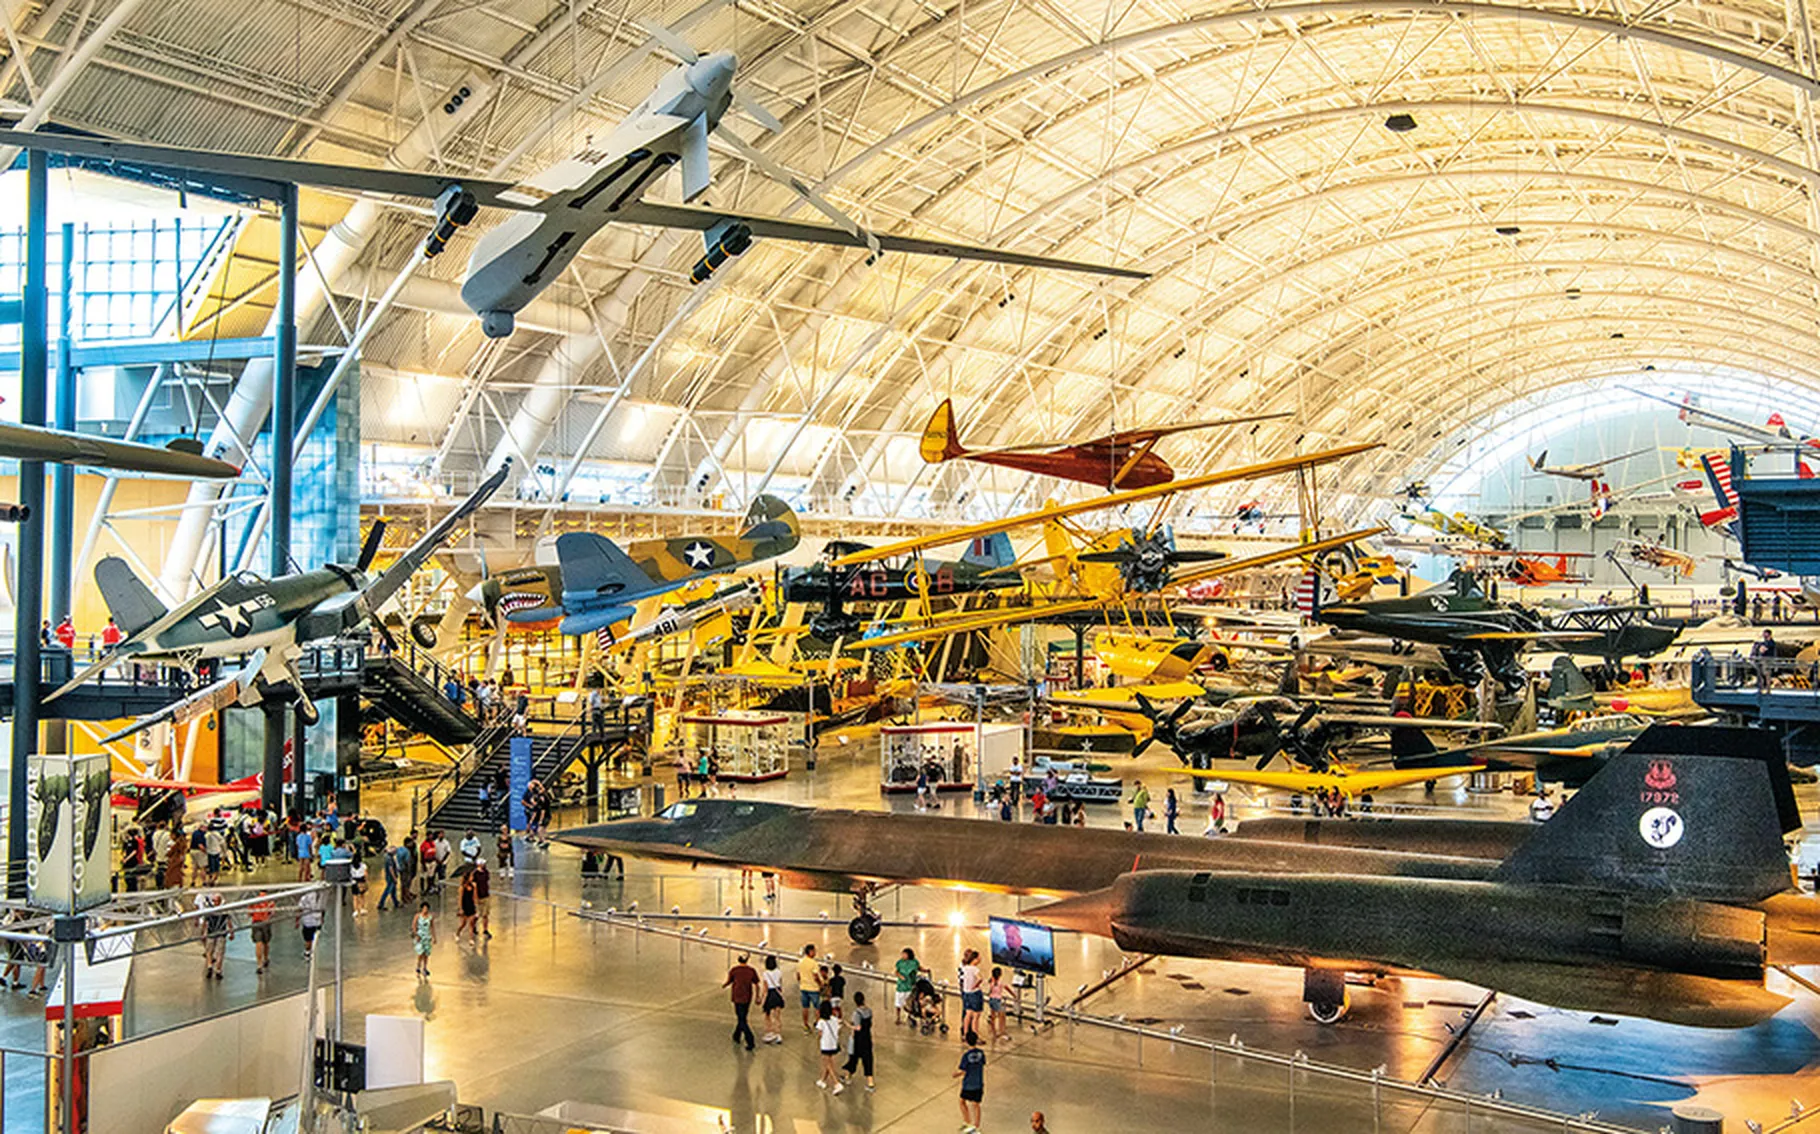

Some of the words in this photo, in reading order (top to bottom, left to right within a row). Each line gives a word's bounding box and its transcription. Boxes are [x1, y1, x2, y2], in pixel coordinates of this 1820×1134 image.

[27, 765, 40, 819] WAR
[27, 828, 39, 890] COLD
[74, 831, 85, 894] COLD
